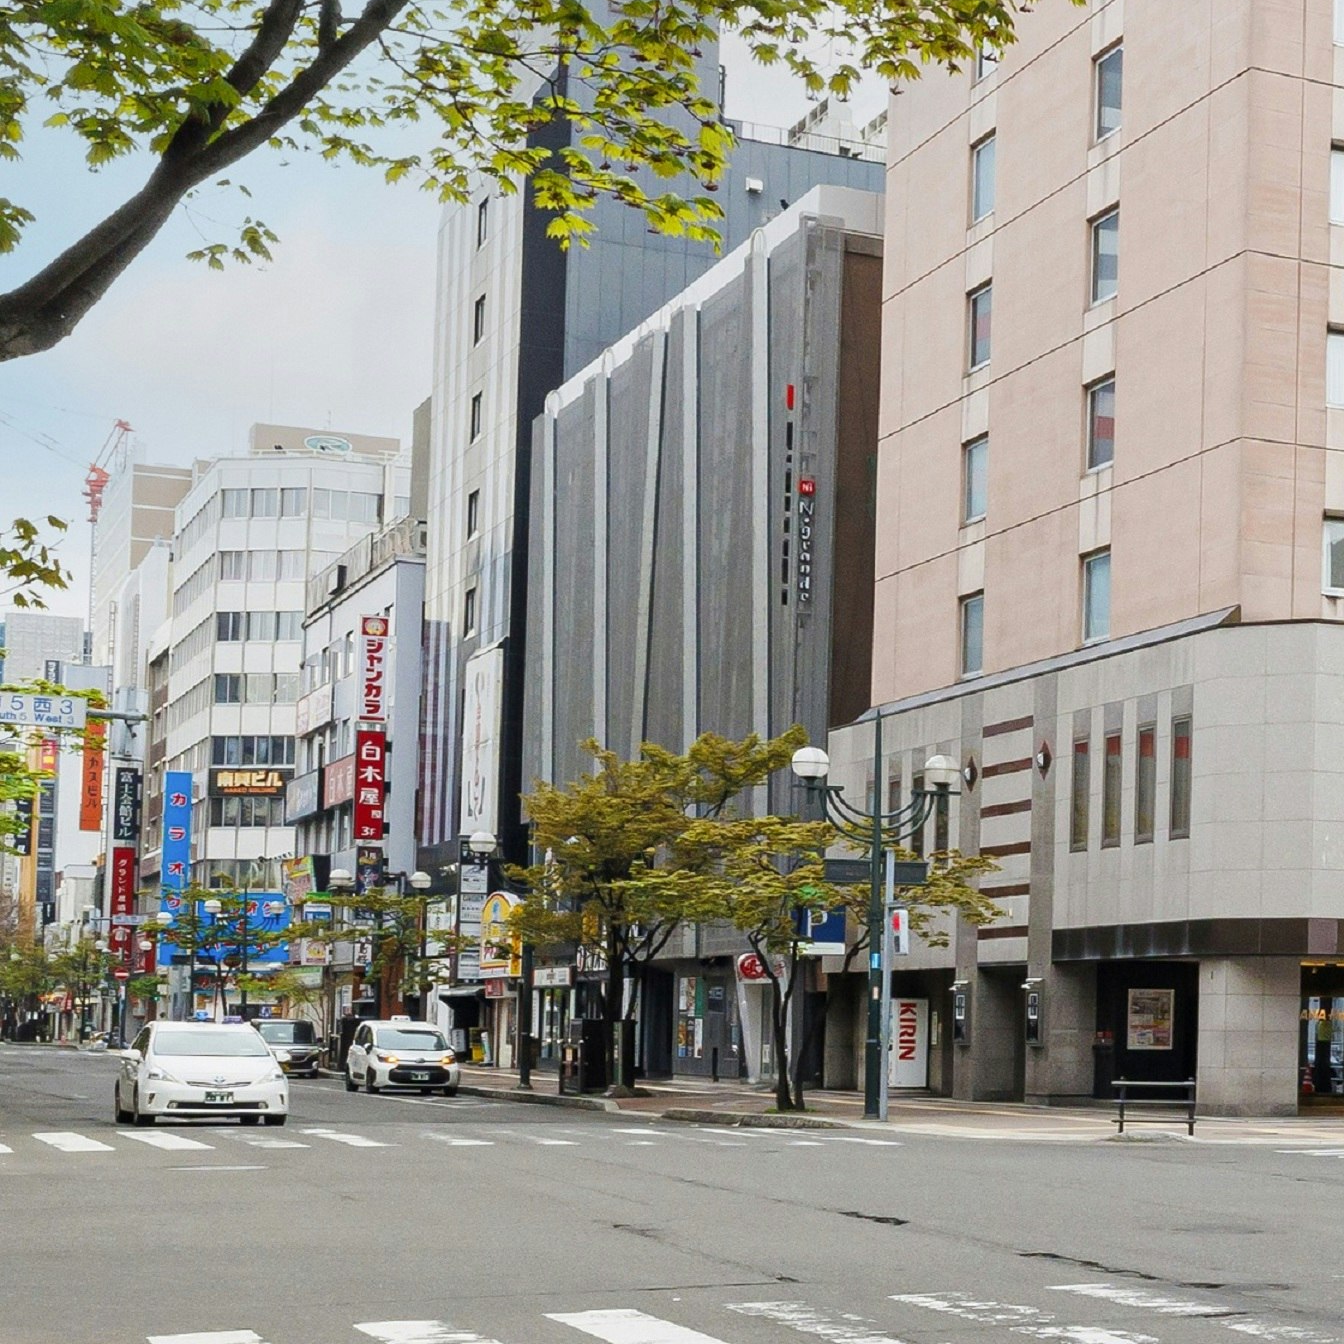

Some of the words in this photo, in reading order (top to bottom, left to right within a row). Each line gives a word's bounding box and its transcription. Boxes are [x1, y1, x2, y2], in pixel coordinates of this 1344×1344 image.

[364, 638, 384, 715] ジャンカラ
[0, 695, 73, 715] 5西3
[0, 711, 17, 721] uth
[34, 713, 62, 723] West
[358, 740, 383, 805] 白木屋
[361, 826, 377, 837] 3F
[898, 1002, 917, 1061] KIRIN
